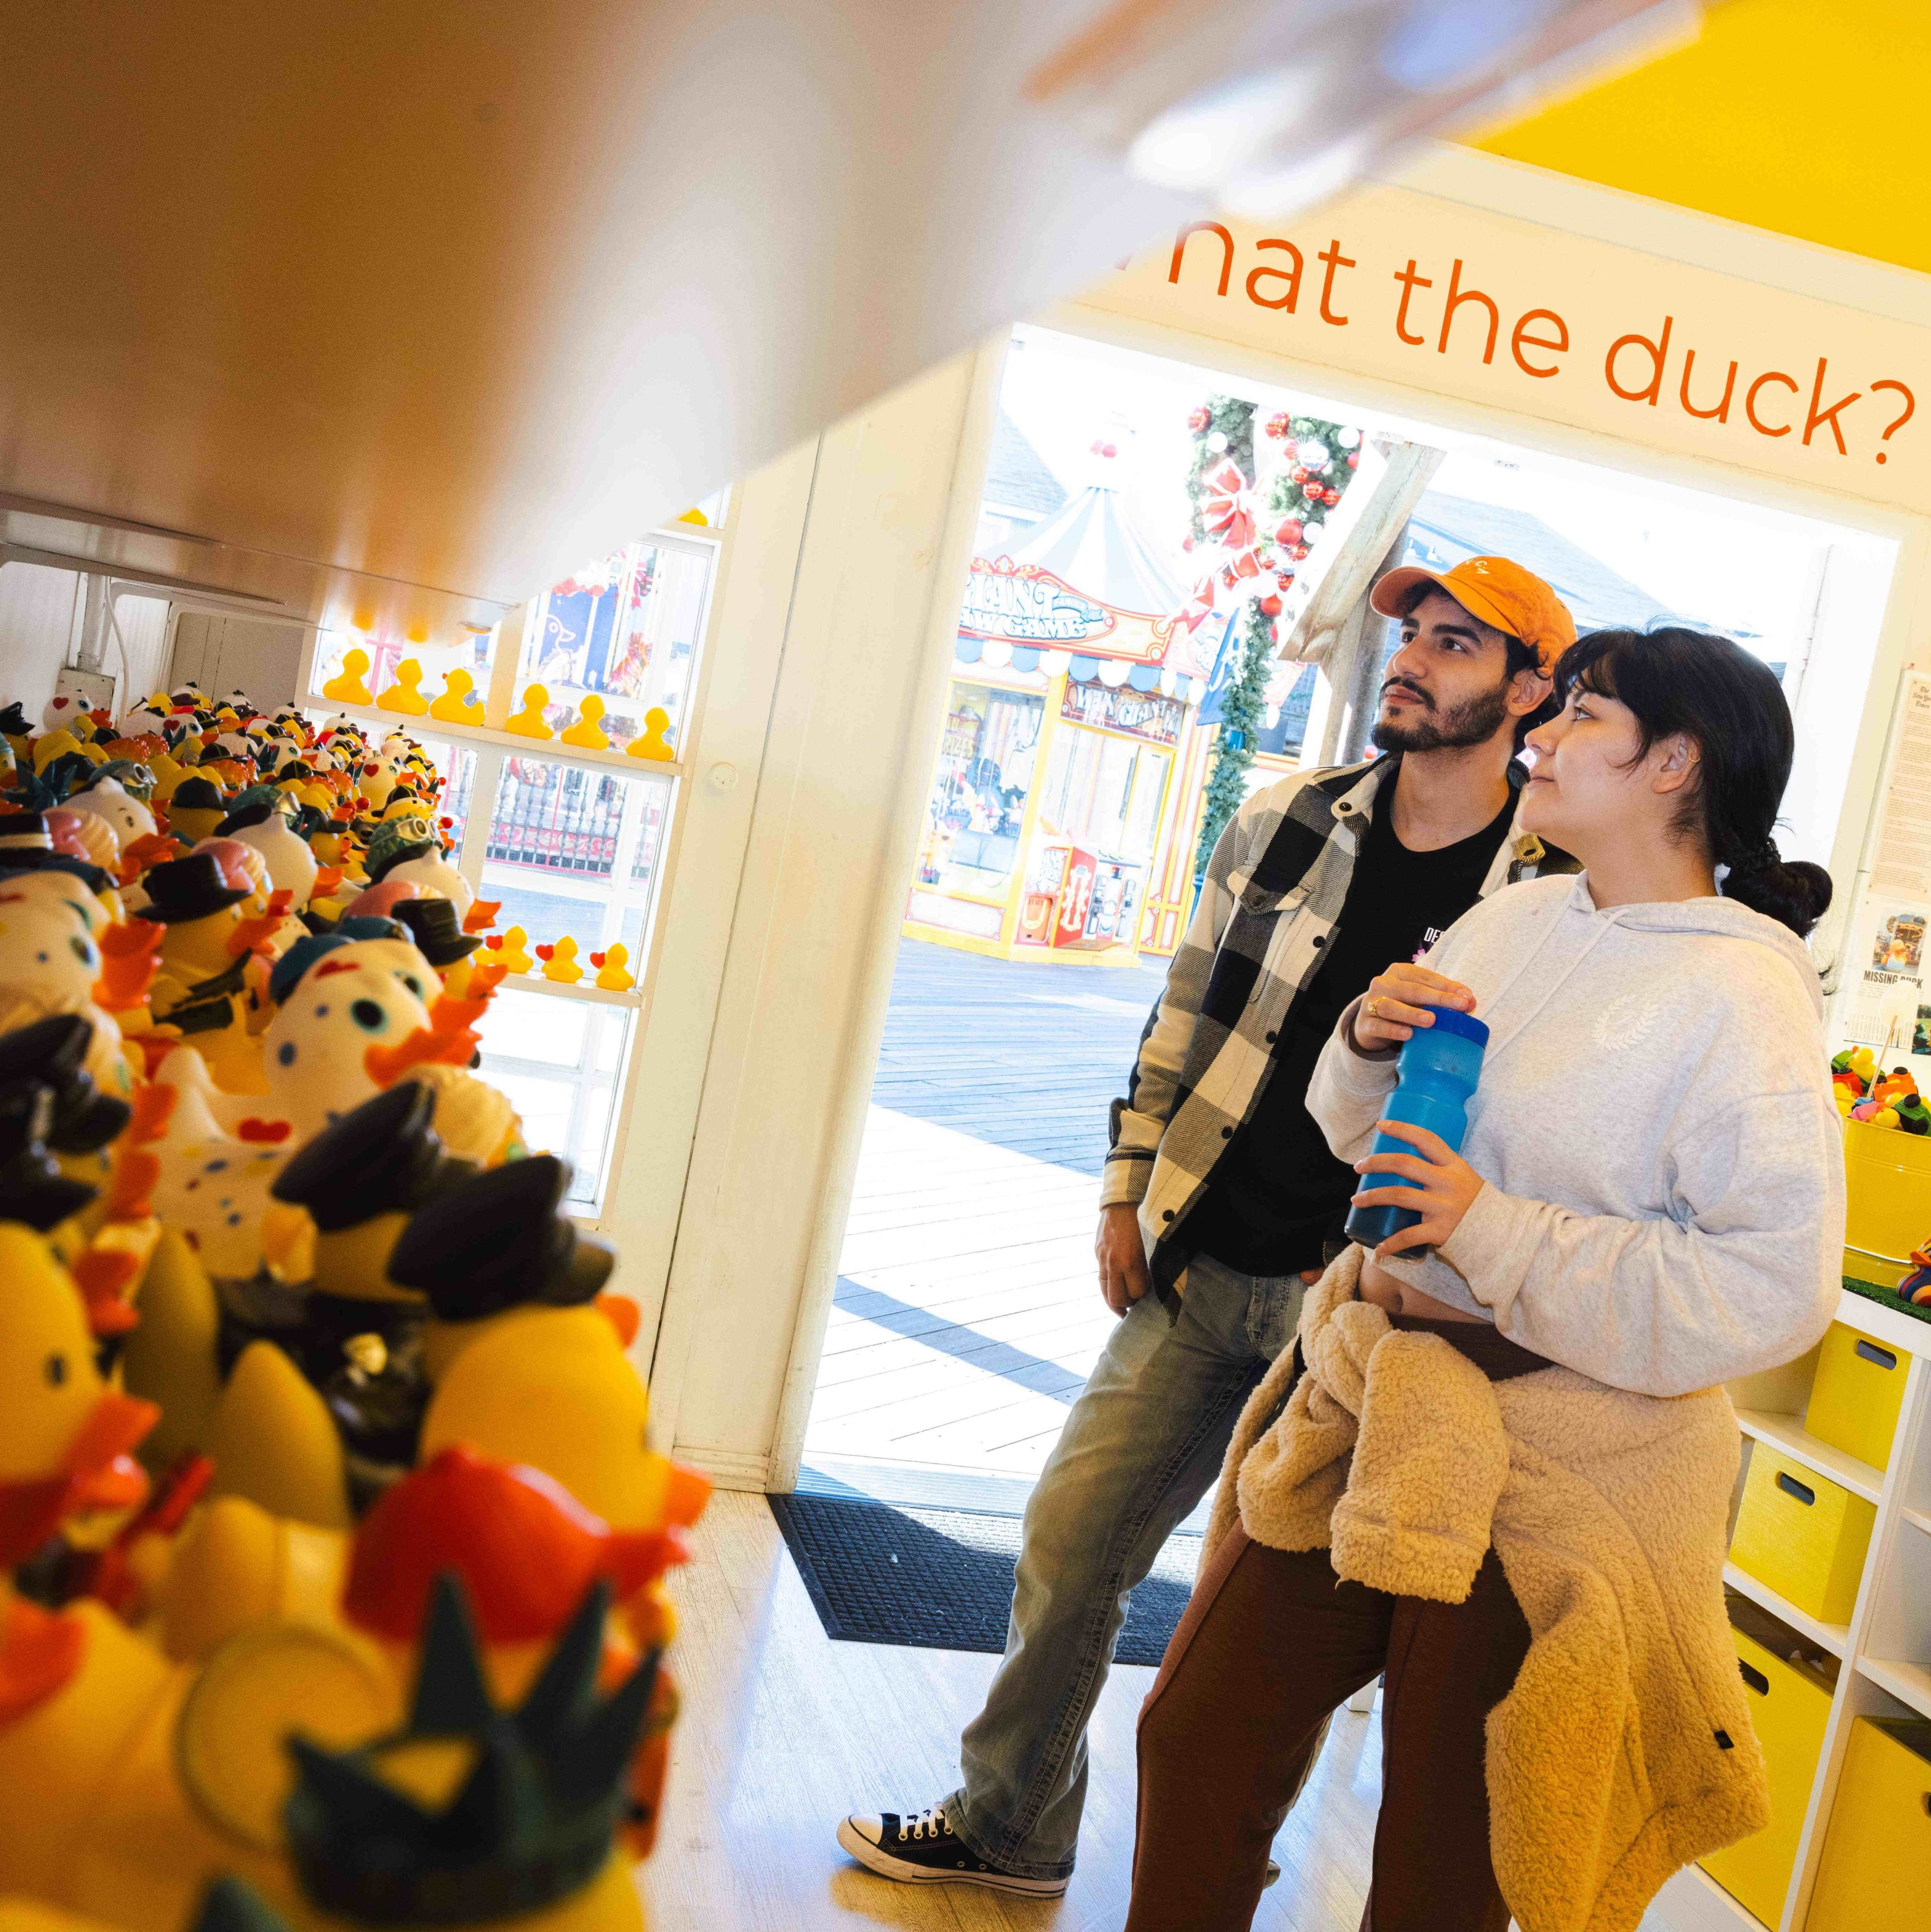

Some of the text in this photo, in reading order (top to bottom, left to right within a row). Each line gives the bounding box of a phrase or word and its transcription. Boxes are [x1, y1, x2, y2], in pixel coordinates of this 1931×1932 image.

[1393, 259, 1569, 378] the
[1605, 315, 1915, 465] duck?
[1003, 615, 1087, 640] GAME
[1915, 700, 1929, 709] Times
[1863, 970, 1898, 985] MISSING
